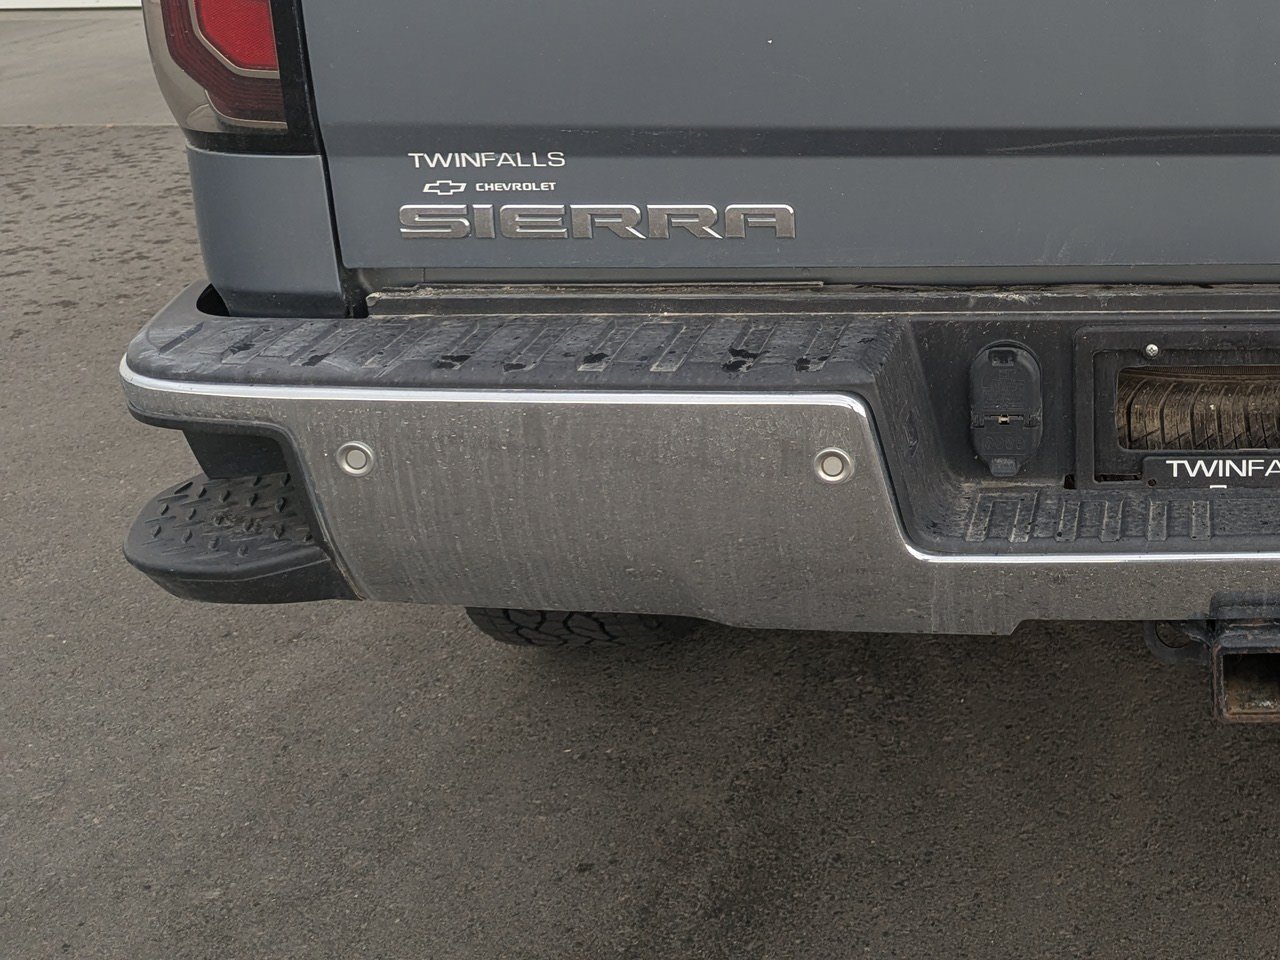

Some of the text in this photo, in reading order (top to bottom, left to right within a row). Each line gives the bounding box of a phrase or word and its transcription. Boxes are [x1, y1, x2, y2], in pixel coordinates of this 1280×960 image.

[408, 151, 566, 168] TWINFALLS
[475, 182, 556, 191] CHEVROLET
[399, 203, 796, 240] SIERRA
